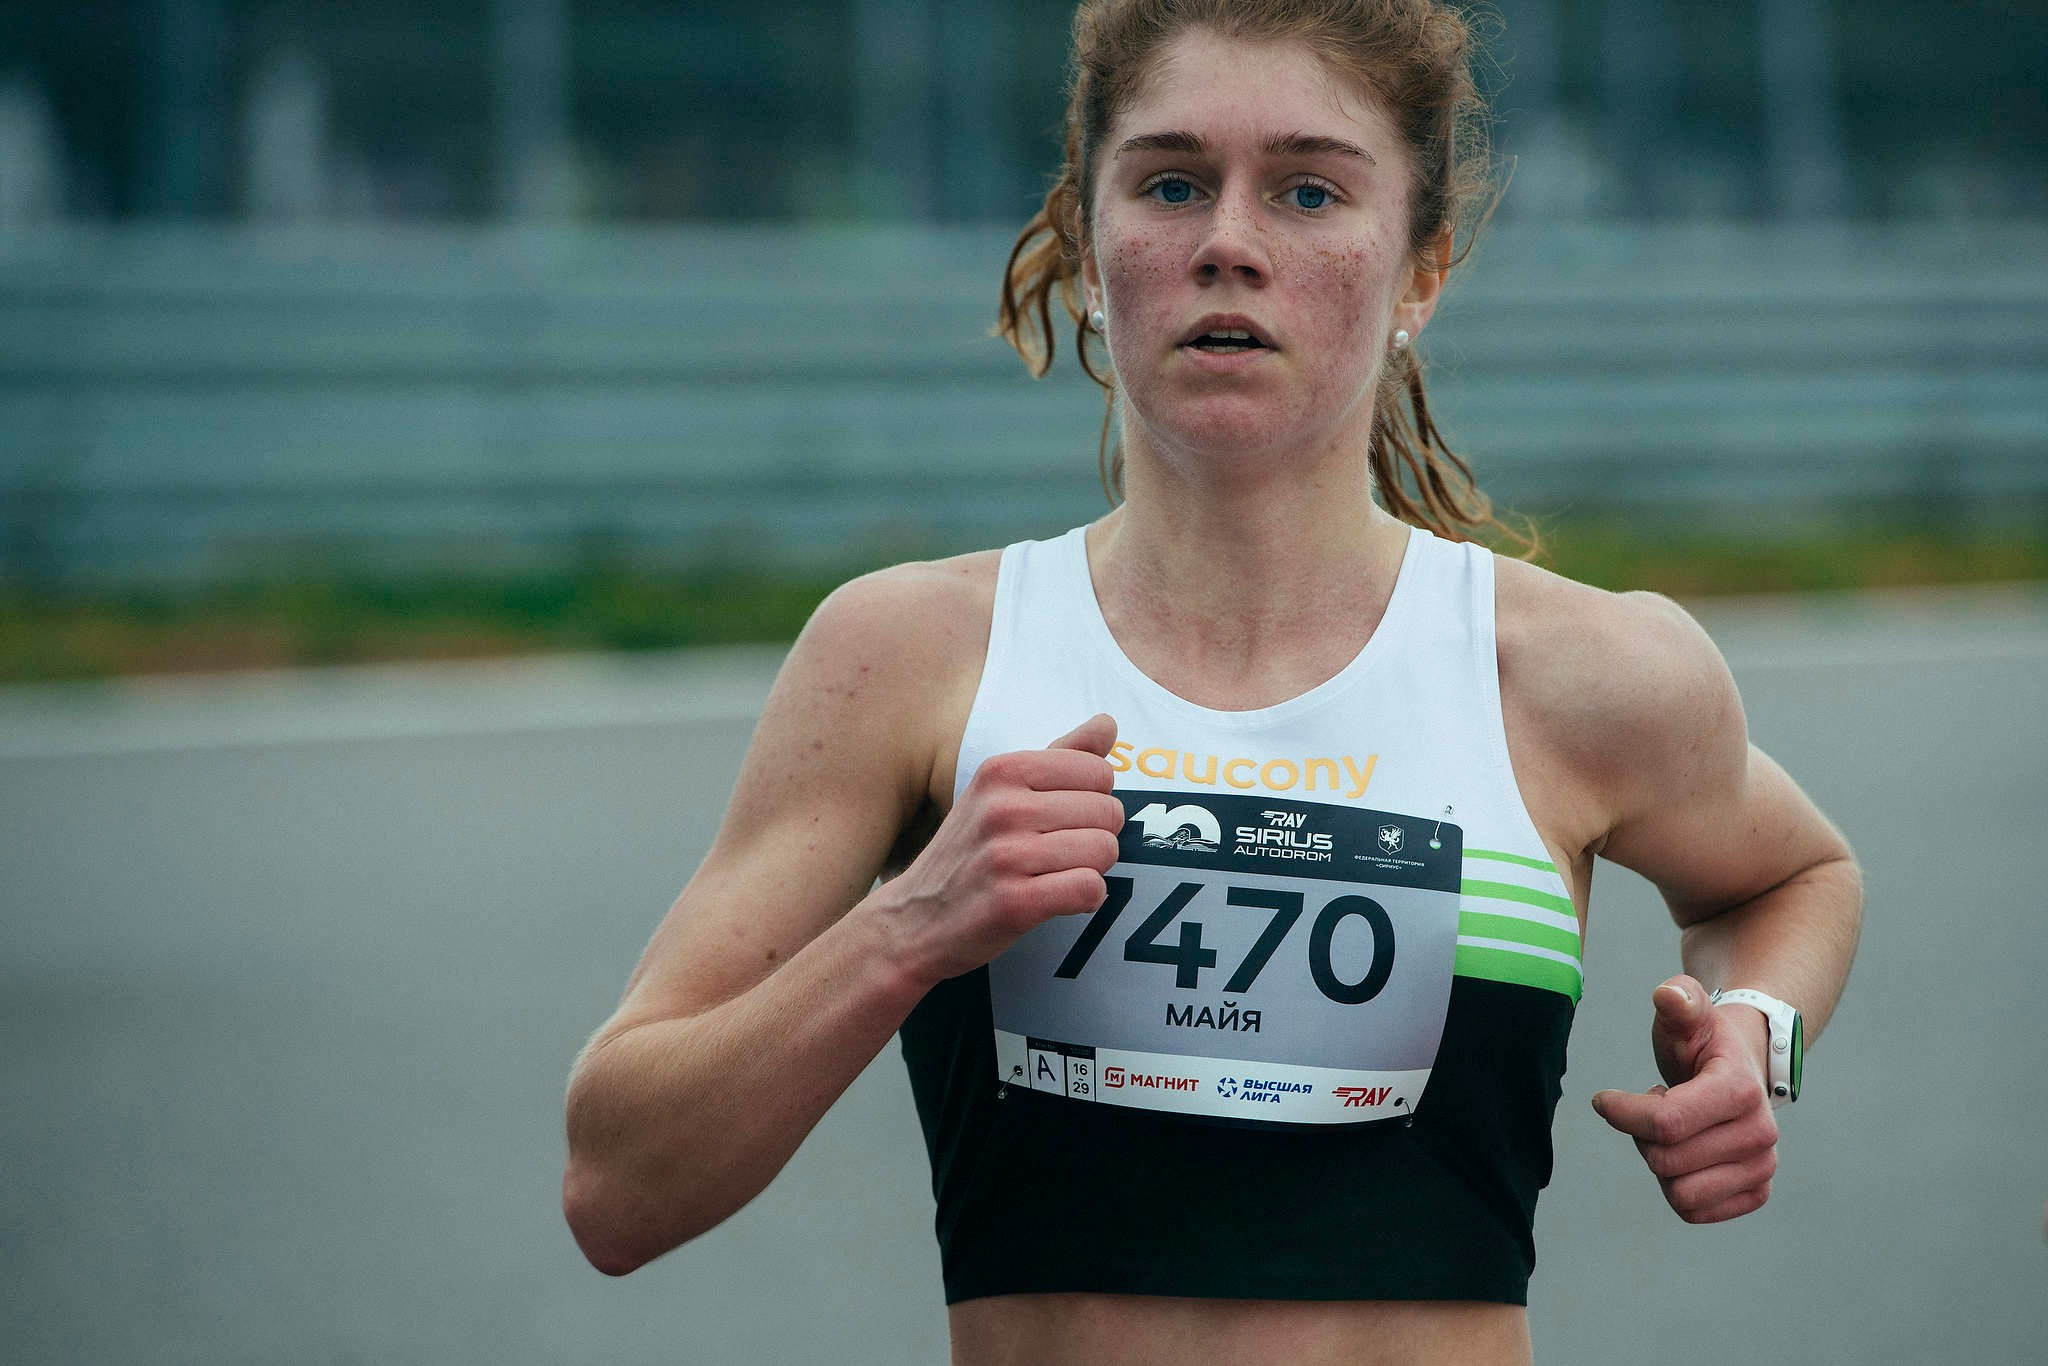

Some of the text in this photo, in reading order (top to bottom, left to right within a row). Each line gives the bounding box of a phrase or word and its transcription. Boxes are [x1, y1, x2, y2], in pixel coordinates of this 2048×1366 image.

[1109, 740, 1379, 799] saucony
[1260, 810, 1308, 829] RAY
[1235, 826, 1334, 850] SIRIUS
[1233, 845, 1332, 863] AUTODROM
[1053, 876, 1396, 1005] 7470
[1165, 1000, 1262, 1033] МАЙЯ
[1072, 1063, 1088, 1076] 16
[1072, 1081, 1090, 1095] 29
[1130, 1073, 1199, 1091] МАГНИТ
[1243, 1079, 1312, 1094] ВЫСШАЯ
[1240, 1091, 1281, 1103] ЛИГА
[1332, 1086, 1392, 1107] RAY
